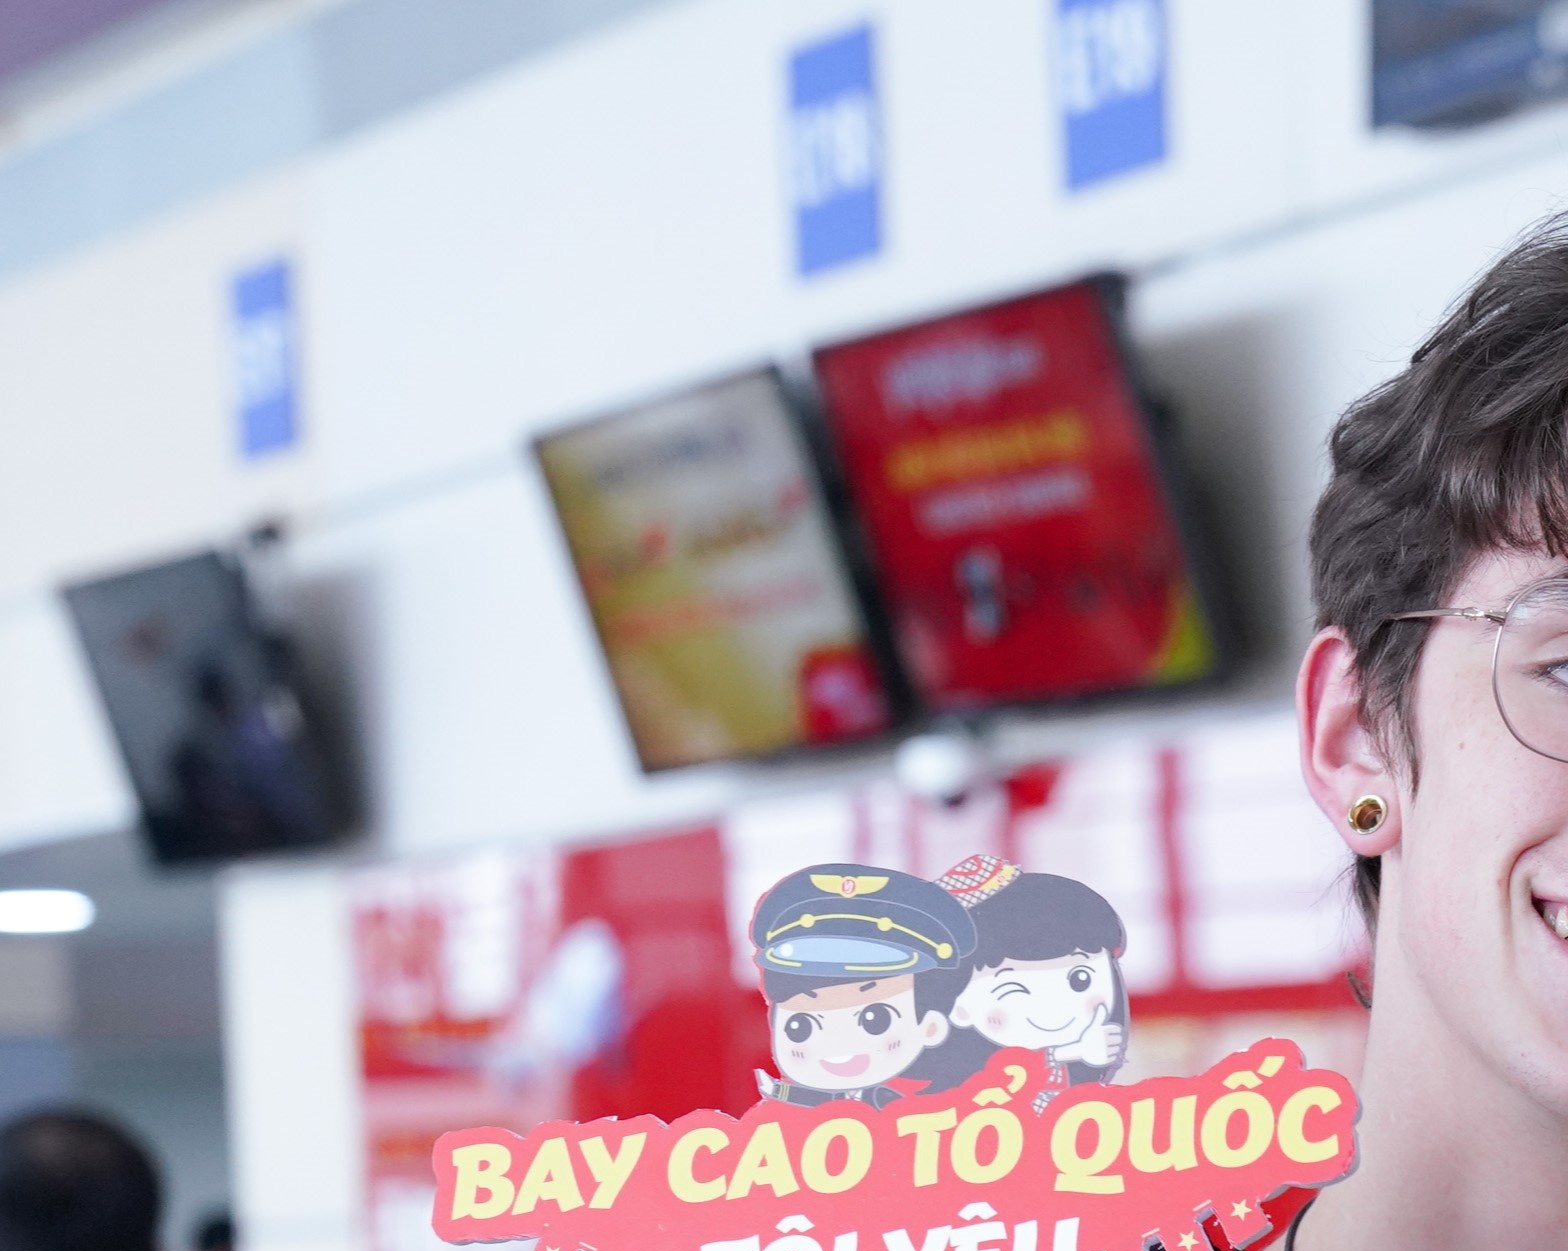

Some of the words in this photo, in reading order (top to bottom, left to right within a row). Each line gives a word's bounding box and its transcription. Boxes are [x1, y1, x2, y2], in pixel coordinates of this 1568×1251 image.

[451, 1132, 646, 1220] BAY
[667, 1119, 873, 1203] CAO
[897, 1065, 1024, 1187] TỔ
[1051, 1056, 1342, 1195] QUỐC
